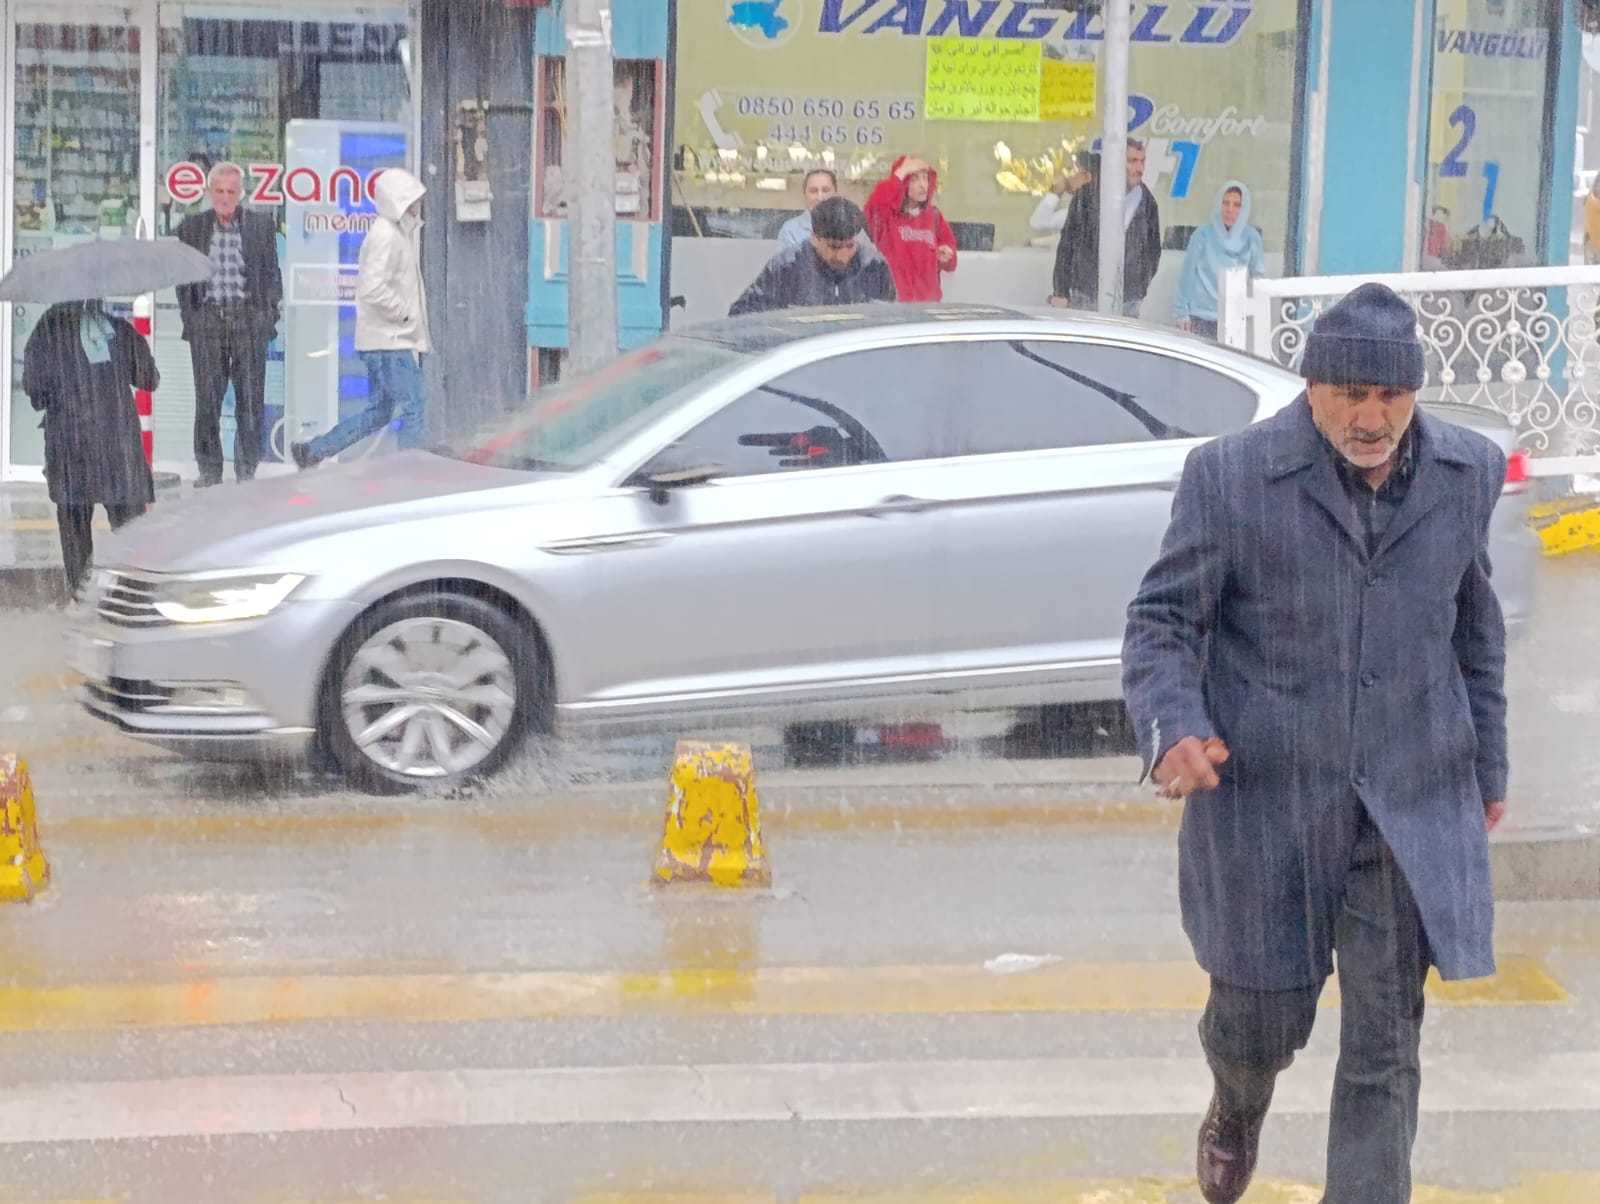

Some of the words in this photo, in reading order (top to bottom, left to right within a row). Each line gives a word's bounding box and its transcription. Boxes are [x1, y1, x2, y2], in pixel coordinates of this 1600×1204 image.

[738, 96, 794, 116] 0850
[803, 99, 844, 118] 650
[853, 100, 880, 119] 65
[888, 101, 916, 120] 65
[770, 122, 811, 143] 444
[820, 125, 847, 144] 65
[856, 126, 882, 145] 65
[1151, 103, 1267, 144] Comfort
